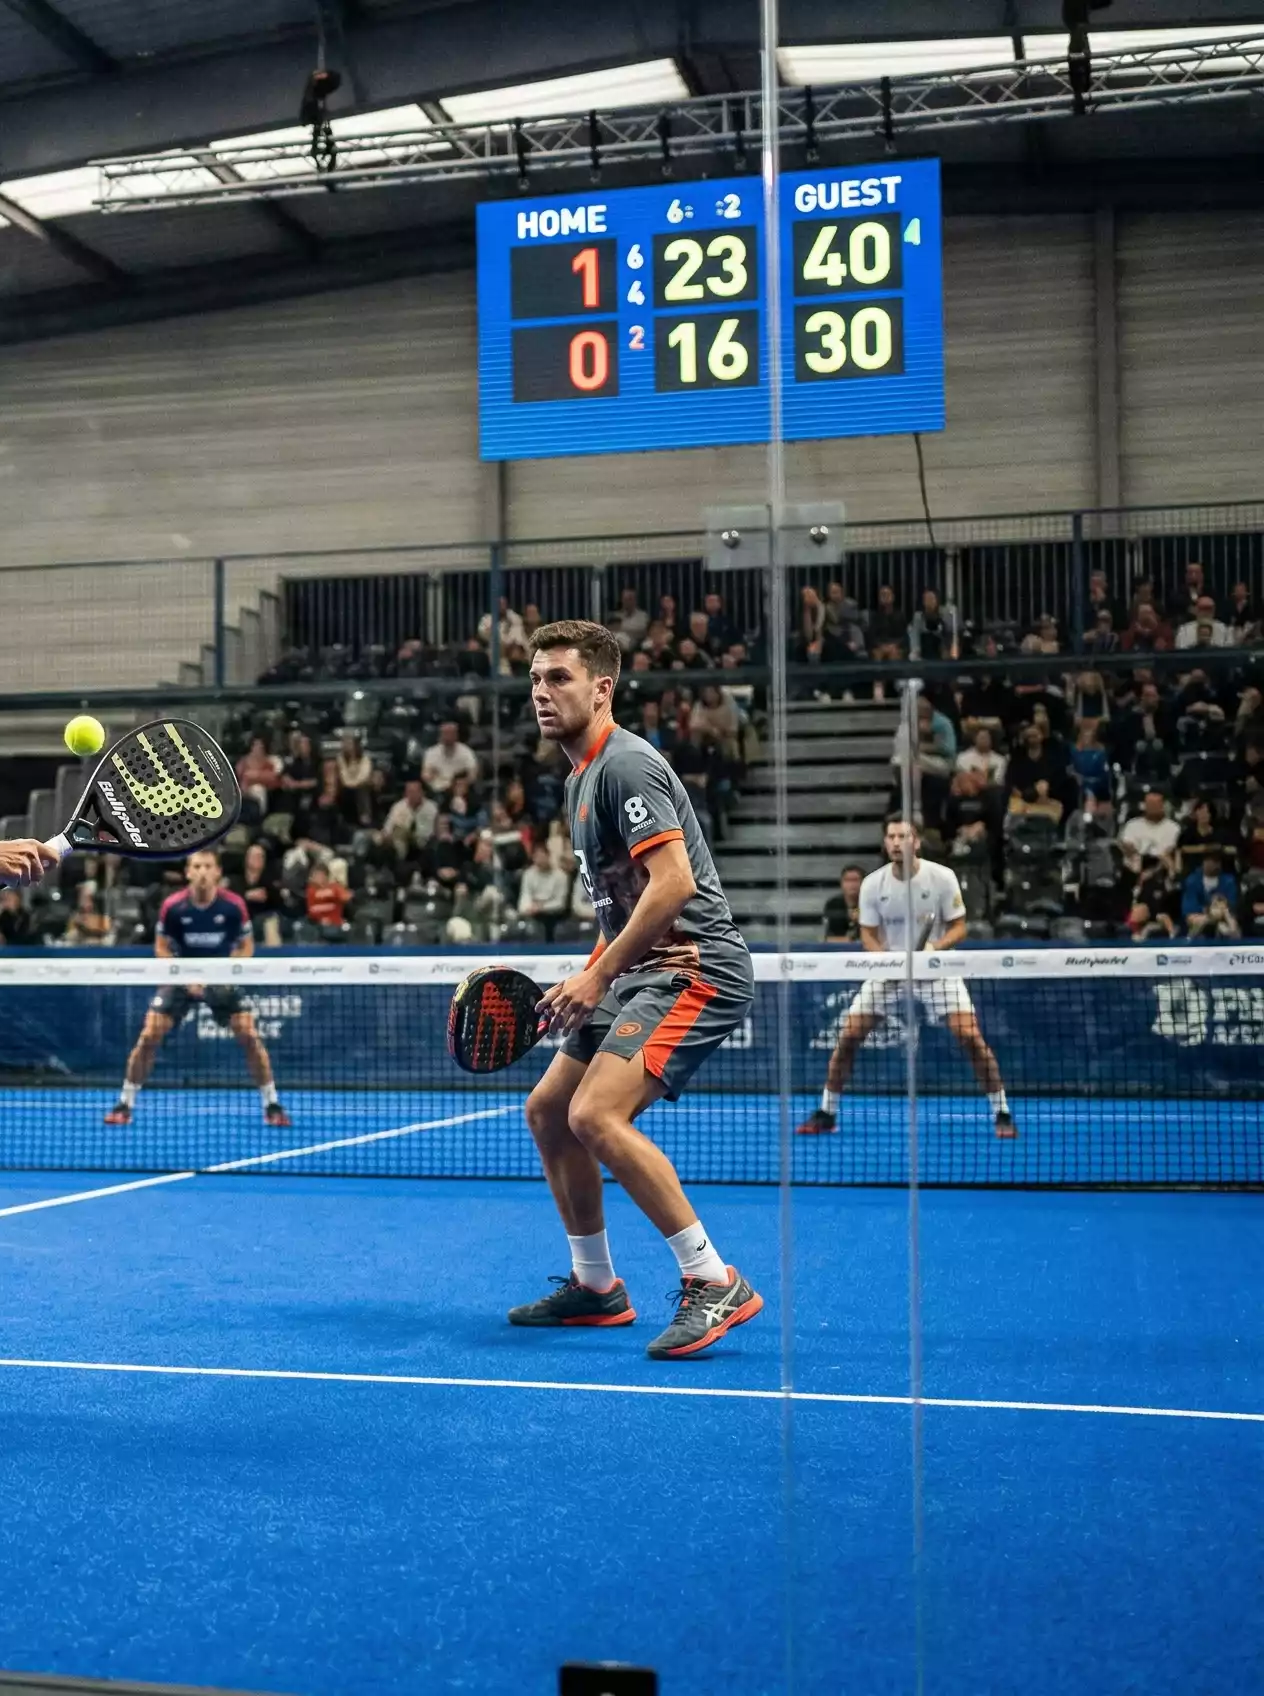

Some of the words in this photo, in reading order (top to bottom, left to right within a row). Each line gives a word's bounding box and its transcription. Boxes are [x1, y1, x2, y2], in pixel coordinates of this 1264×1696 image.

[794, 176, 903, 213] GUEST
[517, 205, 608, 239] HOME
[572, 247, 601, 308] 1
[626, 243, 645, 270] 6
[663, 235, 748, 301] 23
[802, 221, 892, 287] 40
[568, 331, 610, 391] 0
[628, 324, 645, 350] 2
[667, 318, 749, 383] 16
[804, 306, 893, 374] 30
[624, 796, 648, 824] 8
